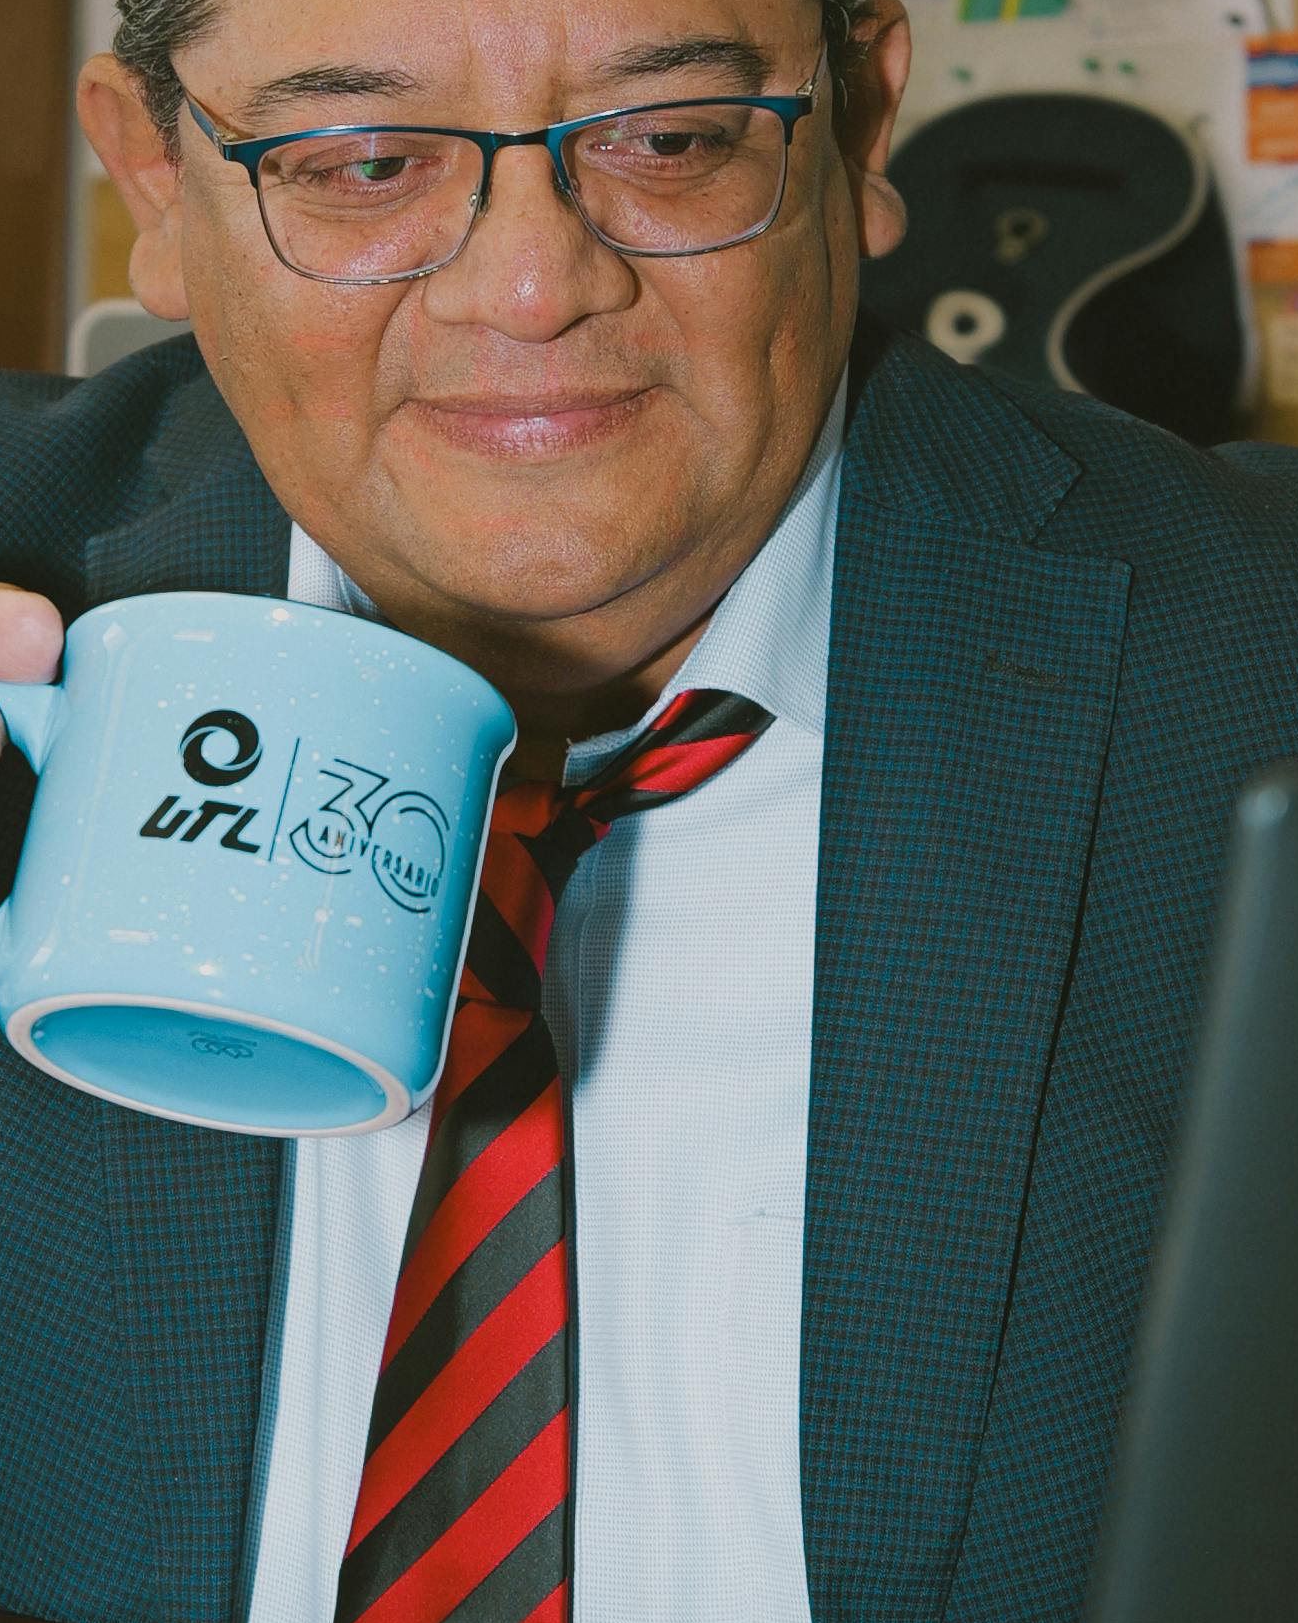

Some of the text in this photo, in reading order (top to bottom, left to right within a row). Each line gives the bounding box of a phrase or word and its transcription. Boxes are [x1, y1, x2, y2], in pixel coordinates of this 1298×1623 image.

[138, 794, 261, 855] UTL
[289, 757, 451, 914] 30
[317, 824, 440, 898] ANIVERSARIO
